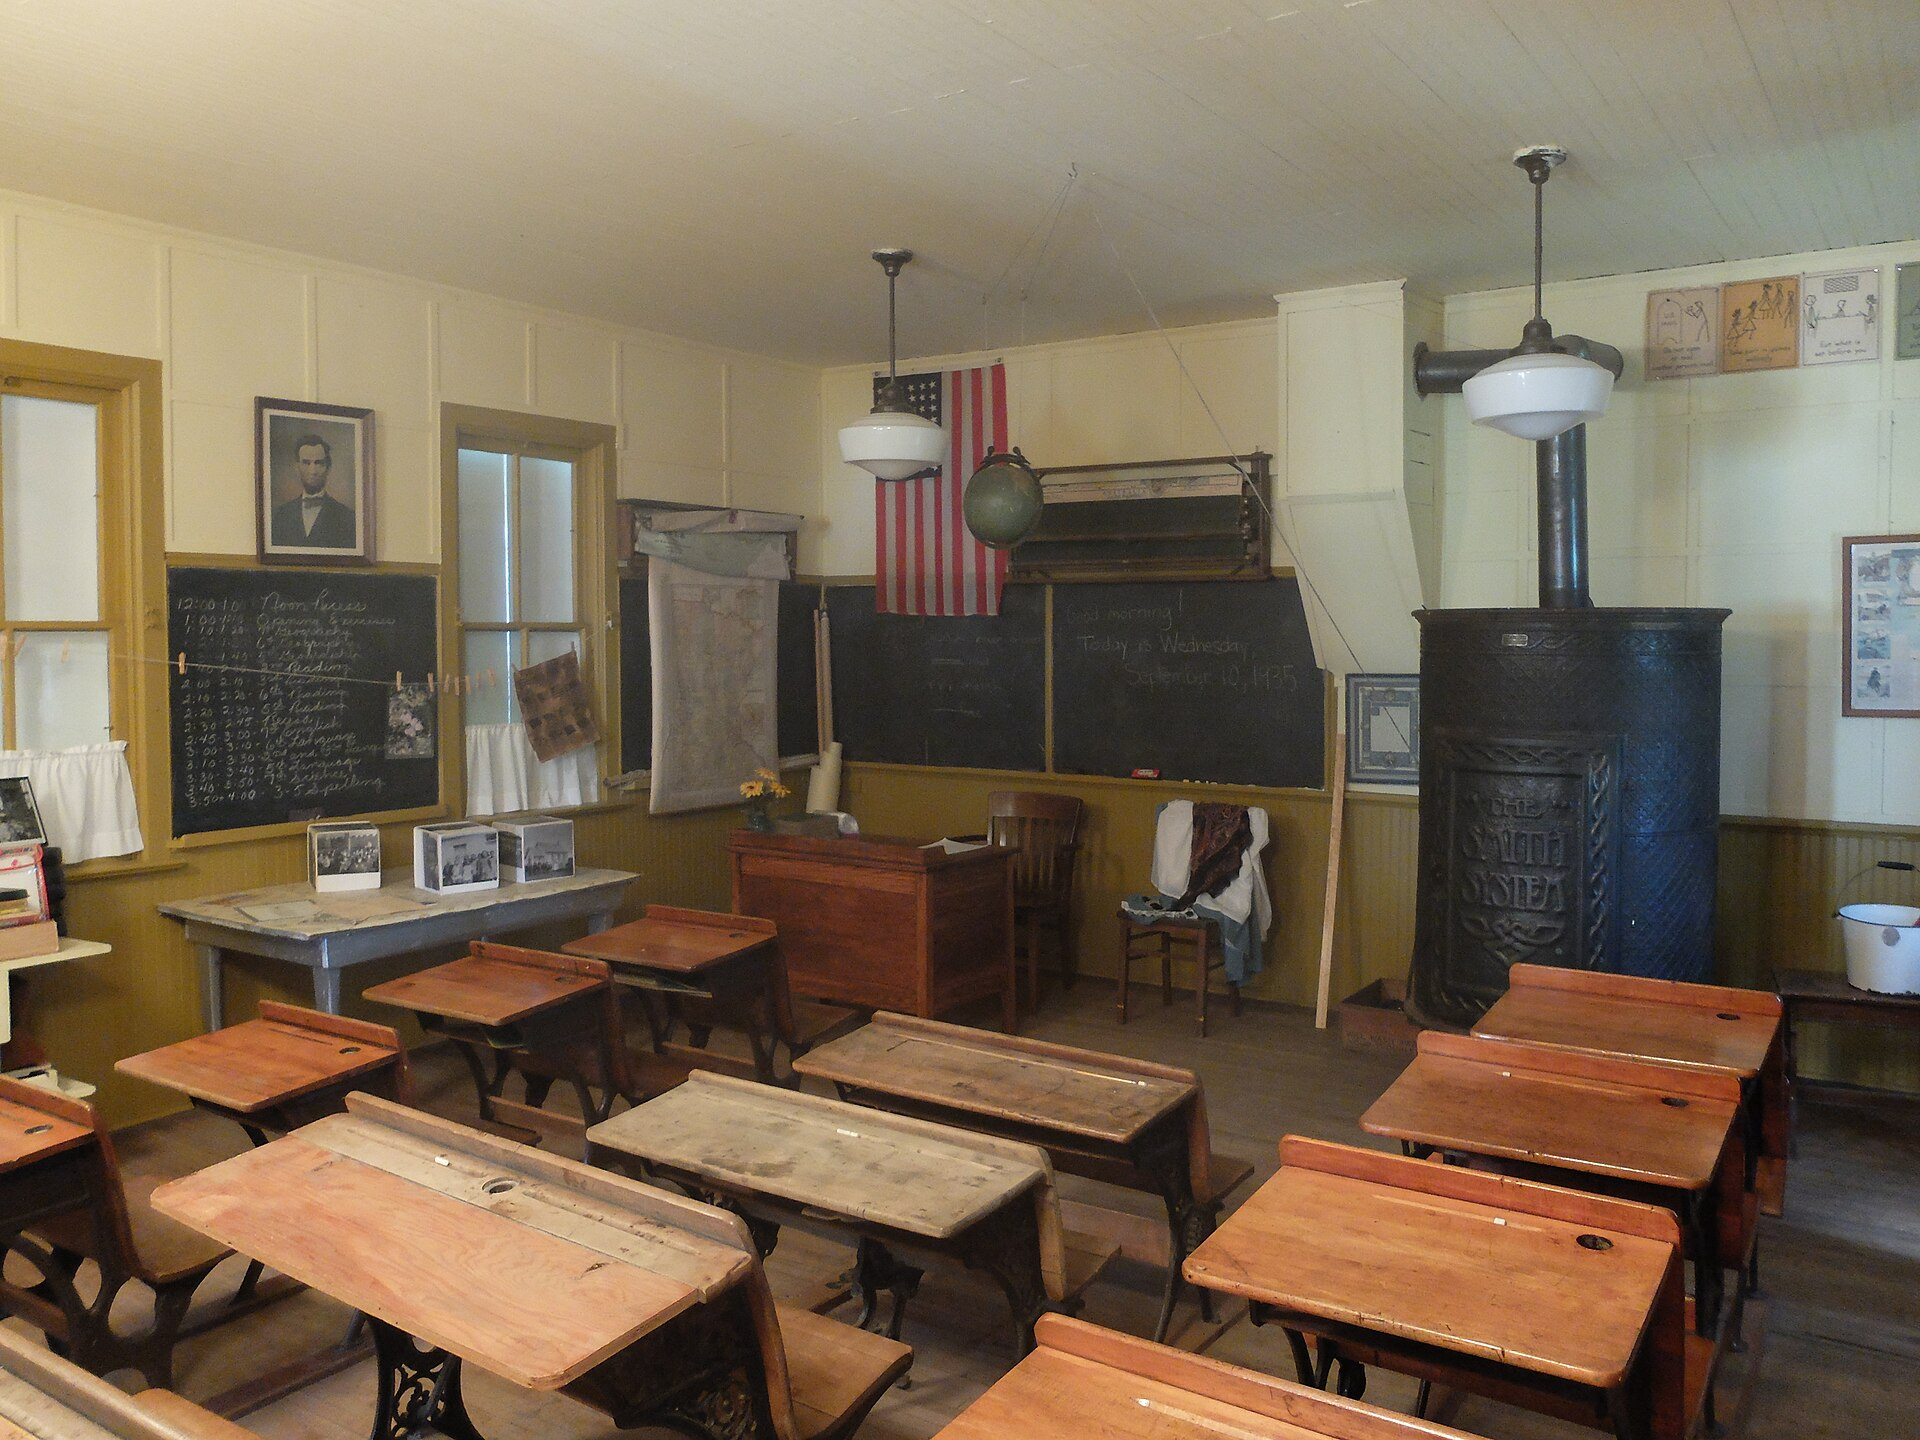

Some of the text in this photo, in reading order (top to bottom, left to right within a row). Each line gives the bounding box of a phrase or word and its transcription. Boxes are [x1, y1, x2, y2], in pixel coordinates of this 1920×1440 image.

[1077, 633, 1129, 661] Today
[1138, 639, 1153, 654] is
[1489, 797, 1545, 819] THE
[1461, 826, 1568, 867] SMITH
[1460, 870, 1568, 912] SYSTEM
